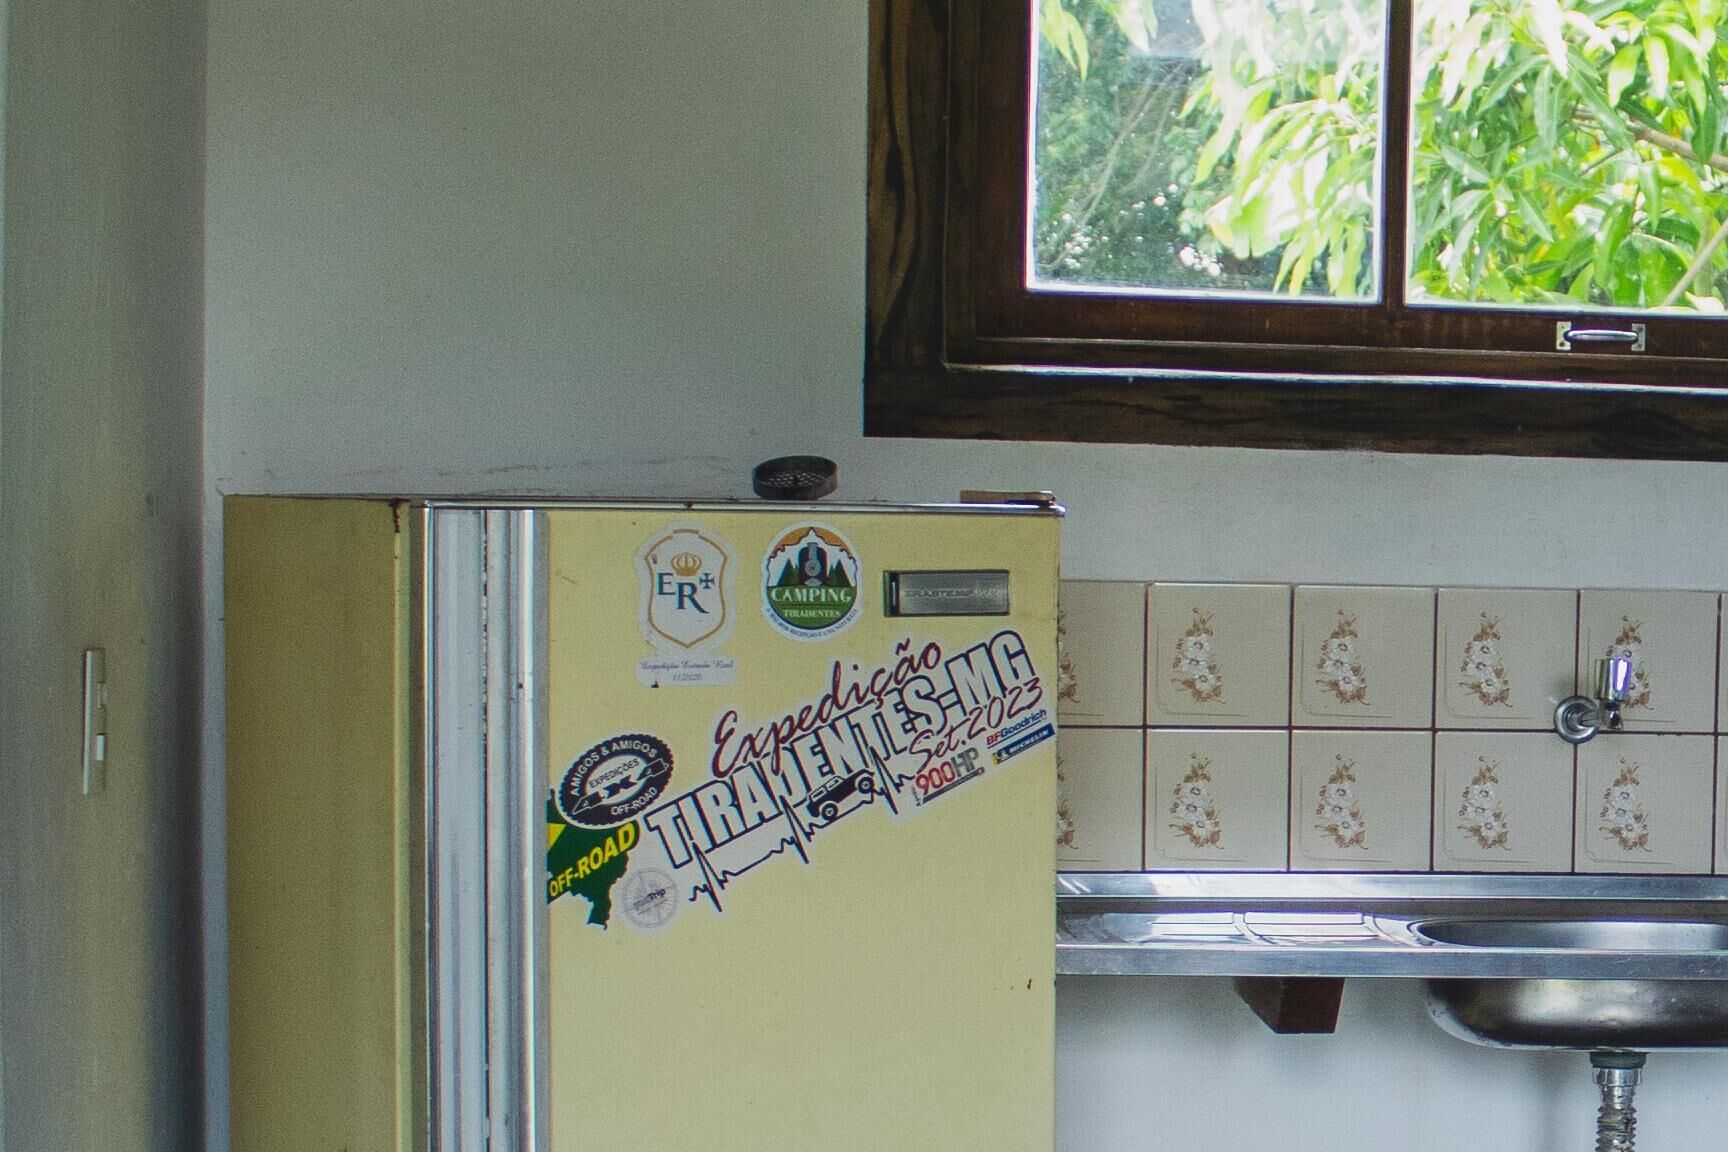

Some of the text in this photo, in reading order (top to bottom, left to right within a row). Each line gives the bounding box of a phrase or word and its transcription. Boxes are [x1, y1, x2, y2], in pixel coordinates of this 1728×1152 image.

[771, 587, 852, 603] CAMPING
[712, 638, 942, 778] Expedição
[986, 708, 1047, 746] BFGoodrich
[570, 740, 658, 796] AMIGOS & AMIGOS
[588, 758, 640, 788] EXPEDIÇÕES
[914, 747, 980, 796] 900HP
[610, 786, 657, 815] OFF-ROAD
[549, 822, 636, 897] OFF-ROAD
